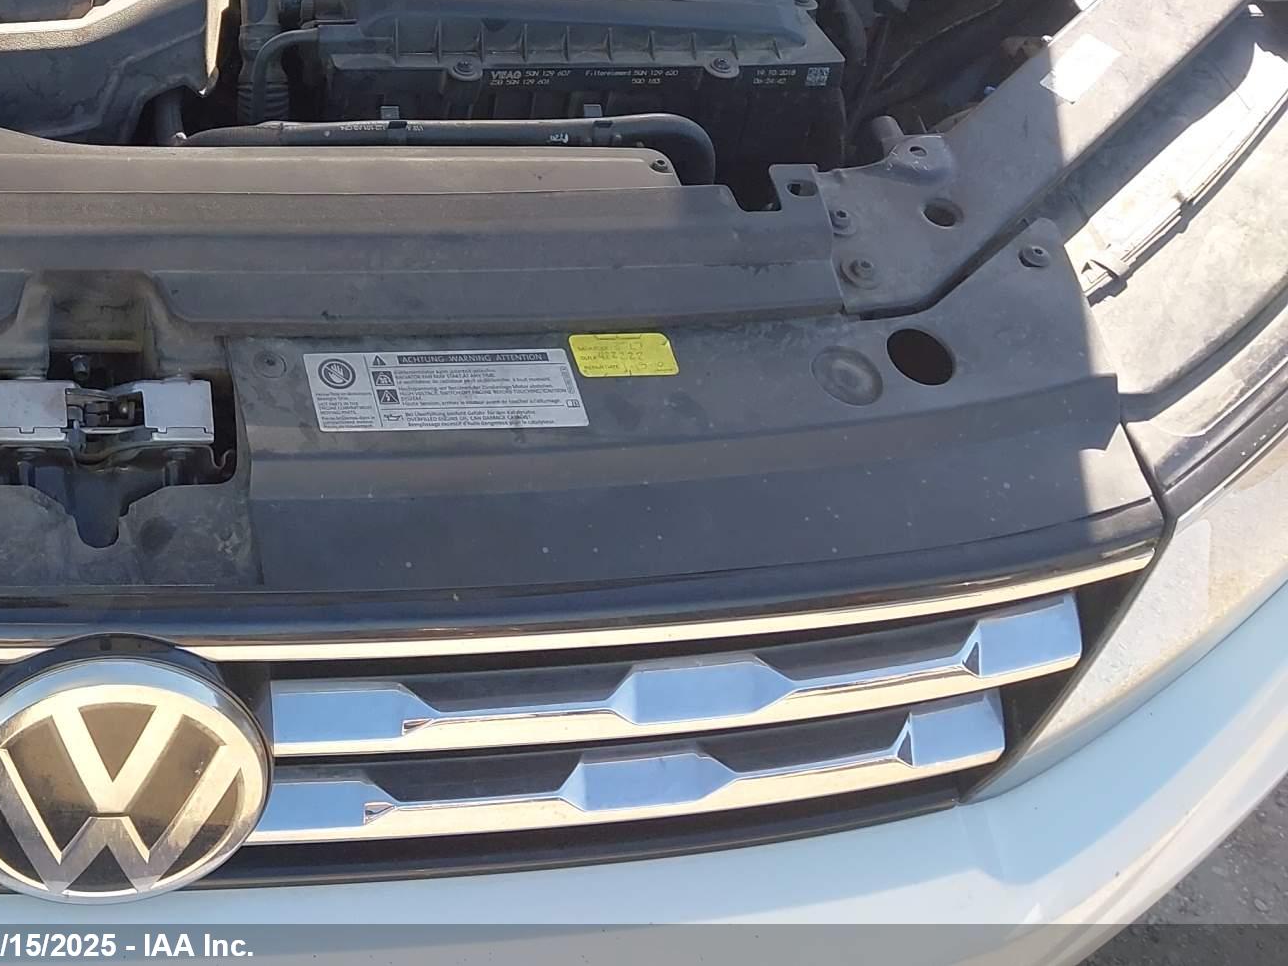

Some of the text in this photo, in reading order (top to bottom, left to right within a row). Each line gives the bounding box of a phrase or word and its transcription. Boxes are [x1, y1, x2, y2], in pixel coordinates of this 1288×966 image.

[402, 352, 543, 363] ACHTUNG WARNING ATTENTION
